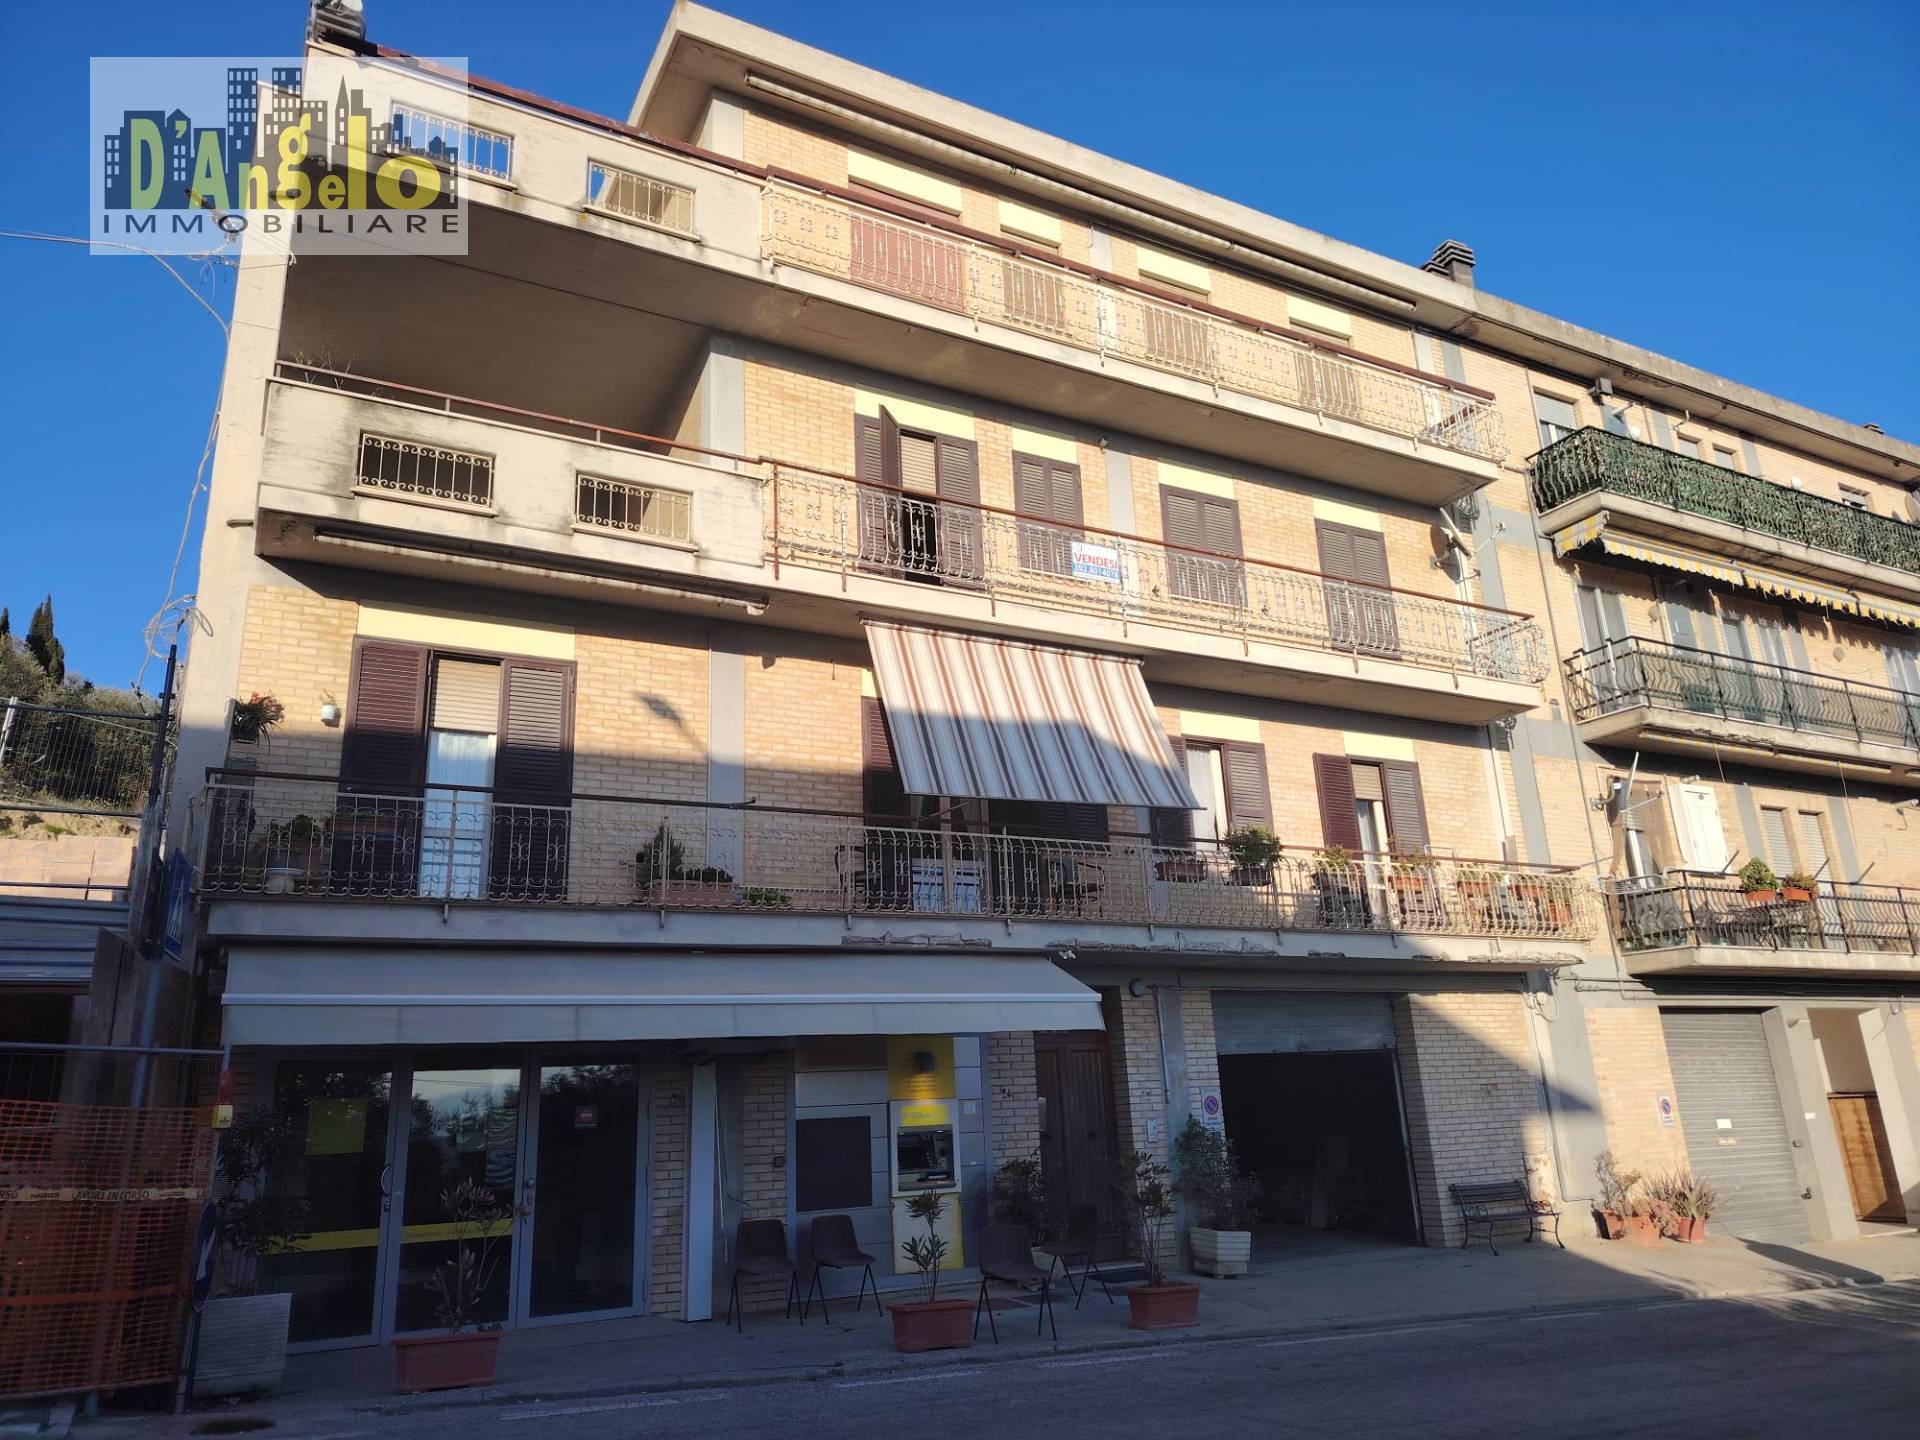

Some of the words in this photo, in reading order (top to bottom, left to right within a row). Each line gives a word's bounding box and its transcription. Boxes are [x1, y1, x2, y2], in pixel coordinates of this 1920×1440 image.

[1074, 552, 1119, 570] VENDESI
[72, 1190, 105, 1200] LAVORI
[107, 1190, 119, 1200] IN
[120, 1190, 150, 1200] CORSO
